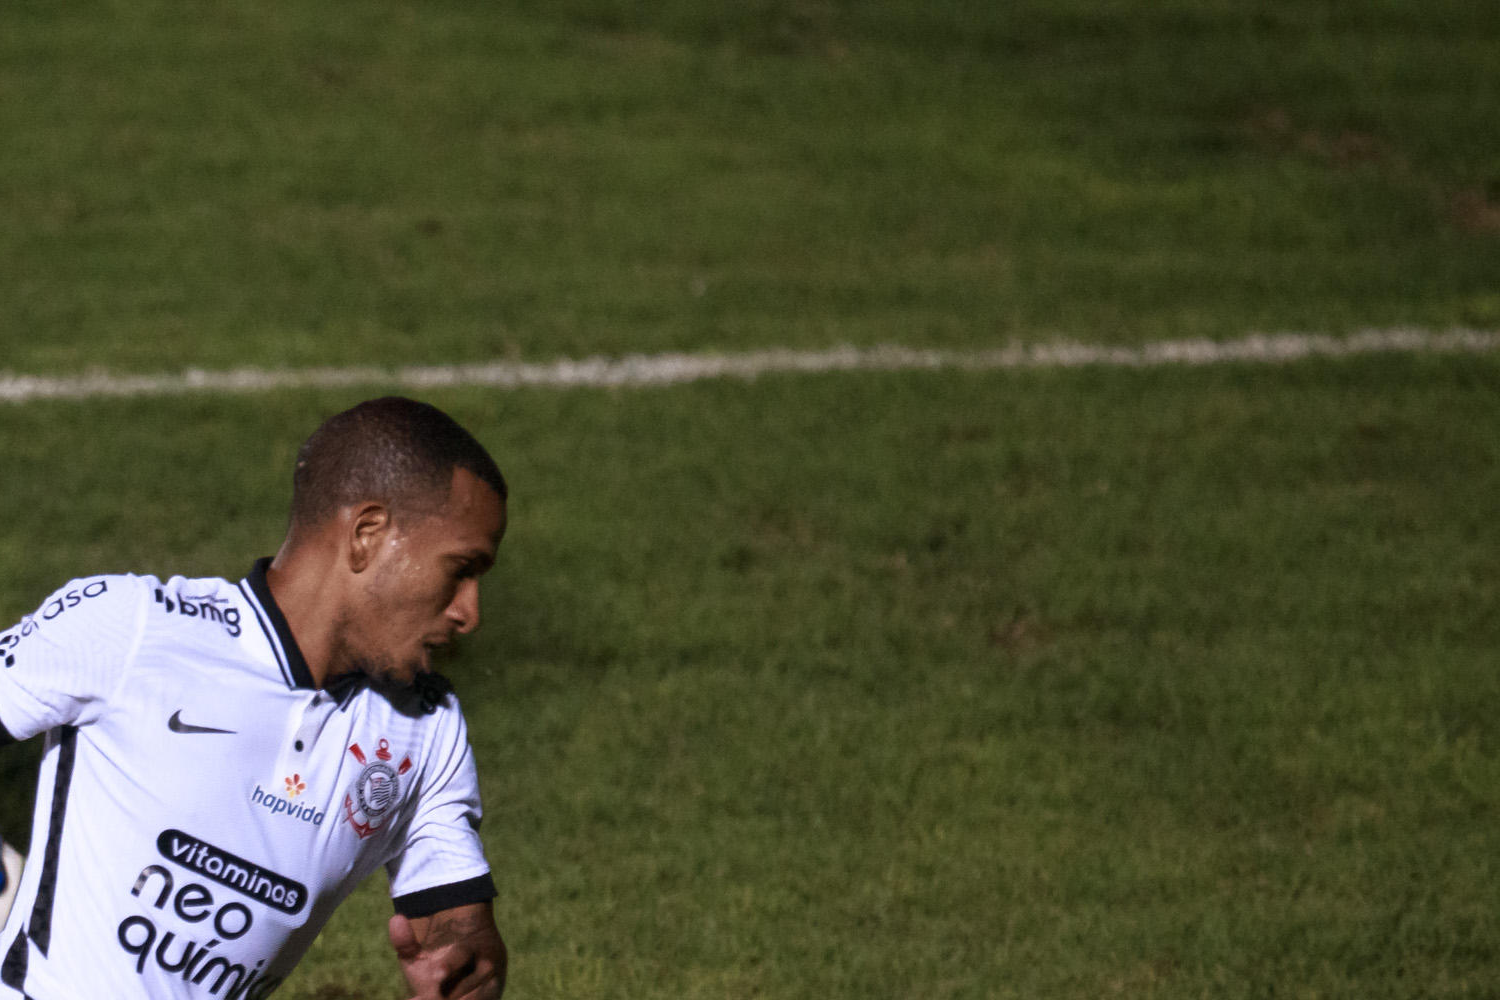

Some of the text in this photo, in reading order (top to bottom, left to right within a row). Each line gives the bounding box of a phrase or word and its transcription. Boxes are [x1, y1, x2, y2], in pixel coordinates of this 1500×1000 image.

[178, 593, 242, 638] bmg
[251, 785, 324, 827] hapvida
[171, 837, 300, 909] vitaminas
[130, 864, 254, 941] neo
